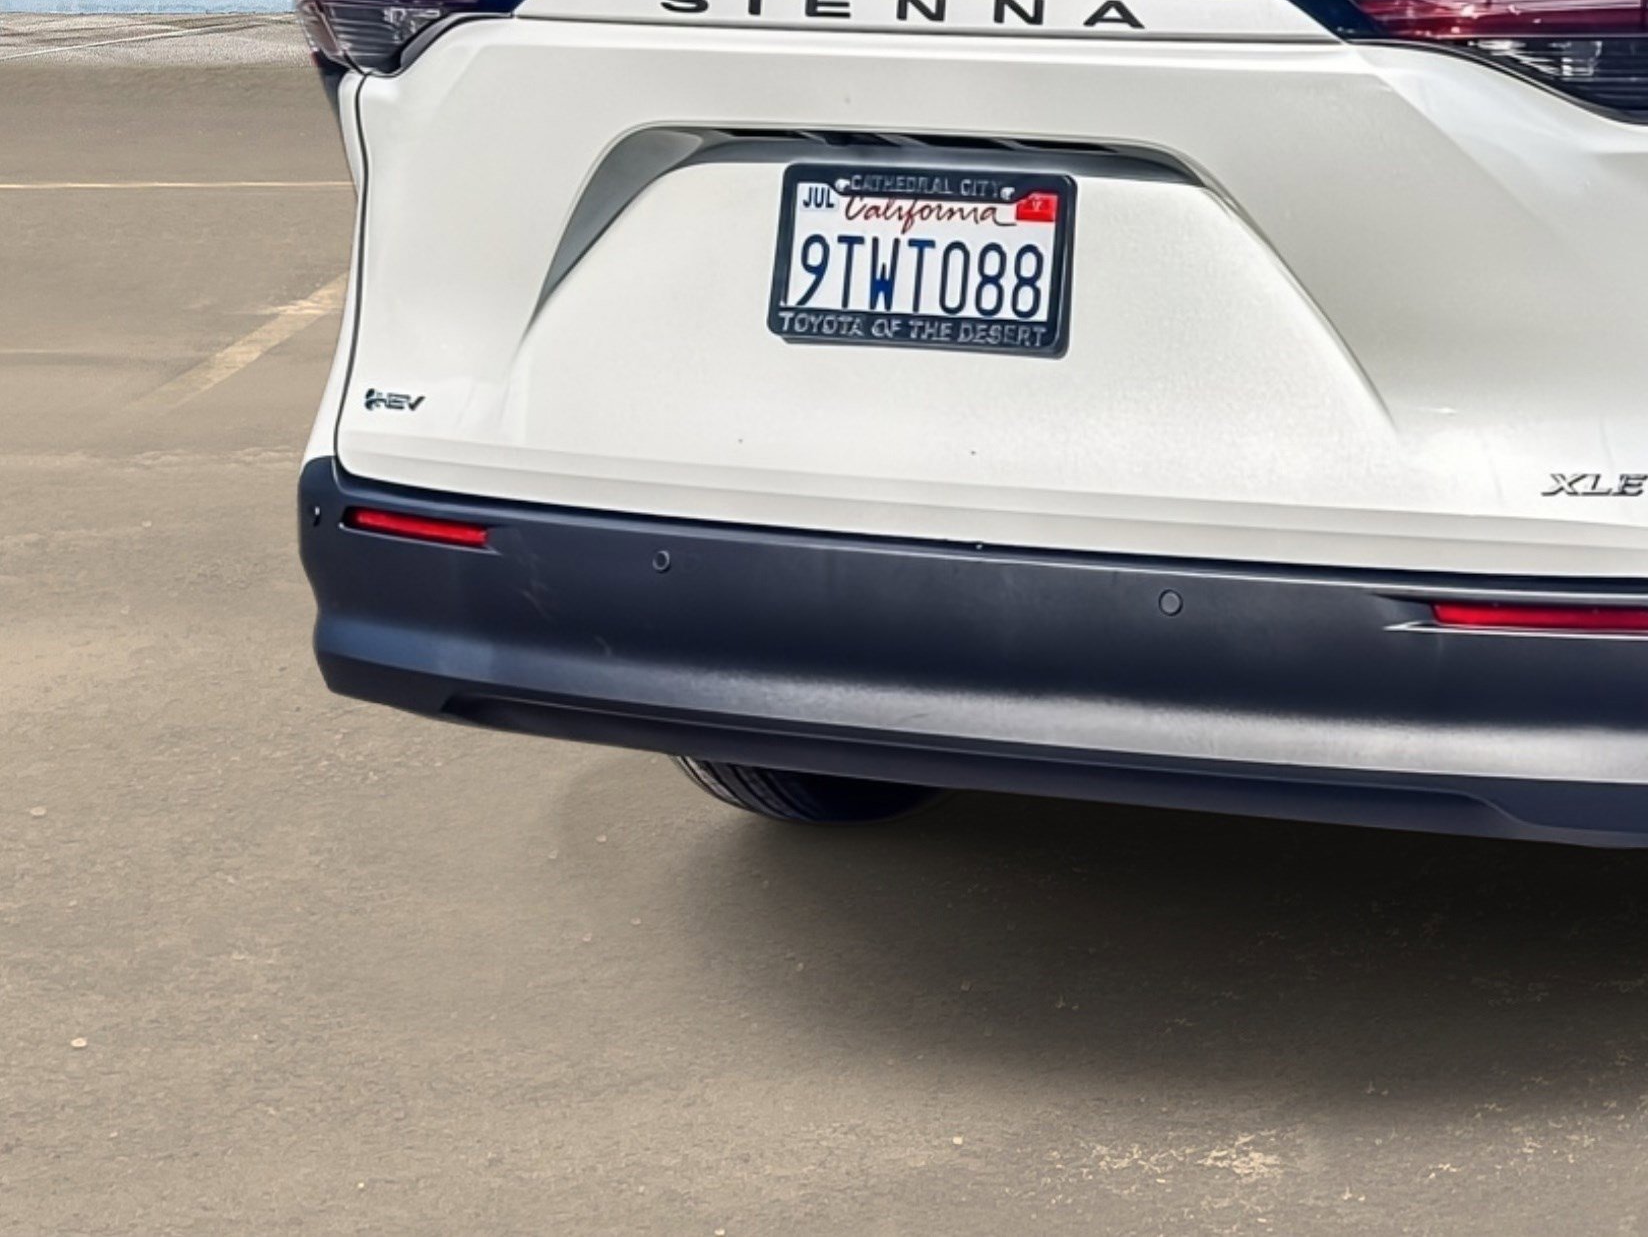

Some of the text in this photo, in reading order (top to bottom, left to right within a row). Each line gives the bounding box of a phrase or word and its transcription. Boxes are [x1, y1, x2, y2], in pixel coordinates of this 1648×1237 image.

[802, 186, 836, 209] JUL
[850, 174, 1001, 198] CATHEDRAL CITY
[845, 195, 1017, 235] California
[796, 233, 1044, 320] 9TWT088
[778, 312, 1047, 348] TOYOTA OF THE DESERT
